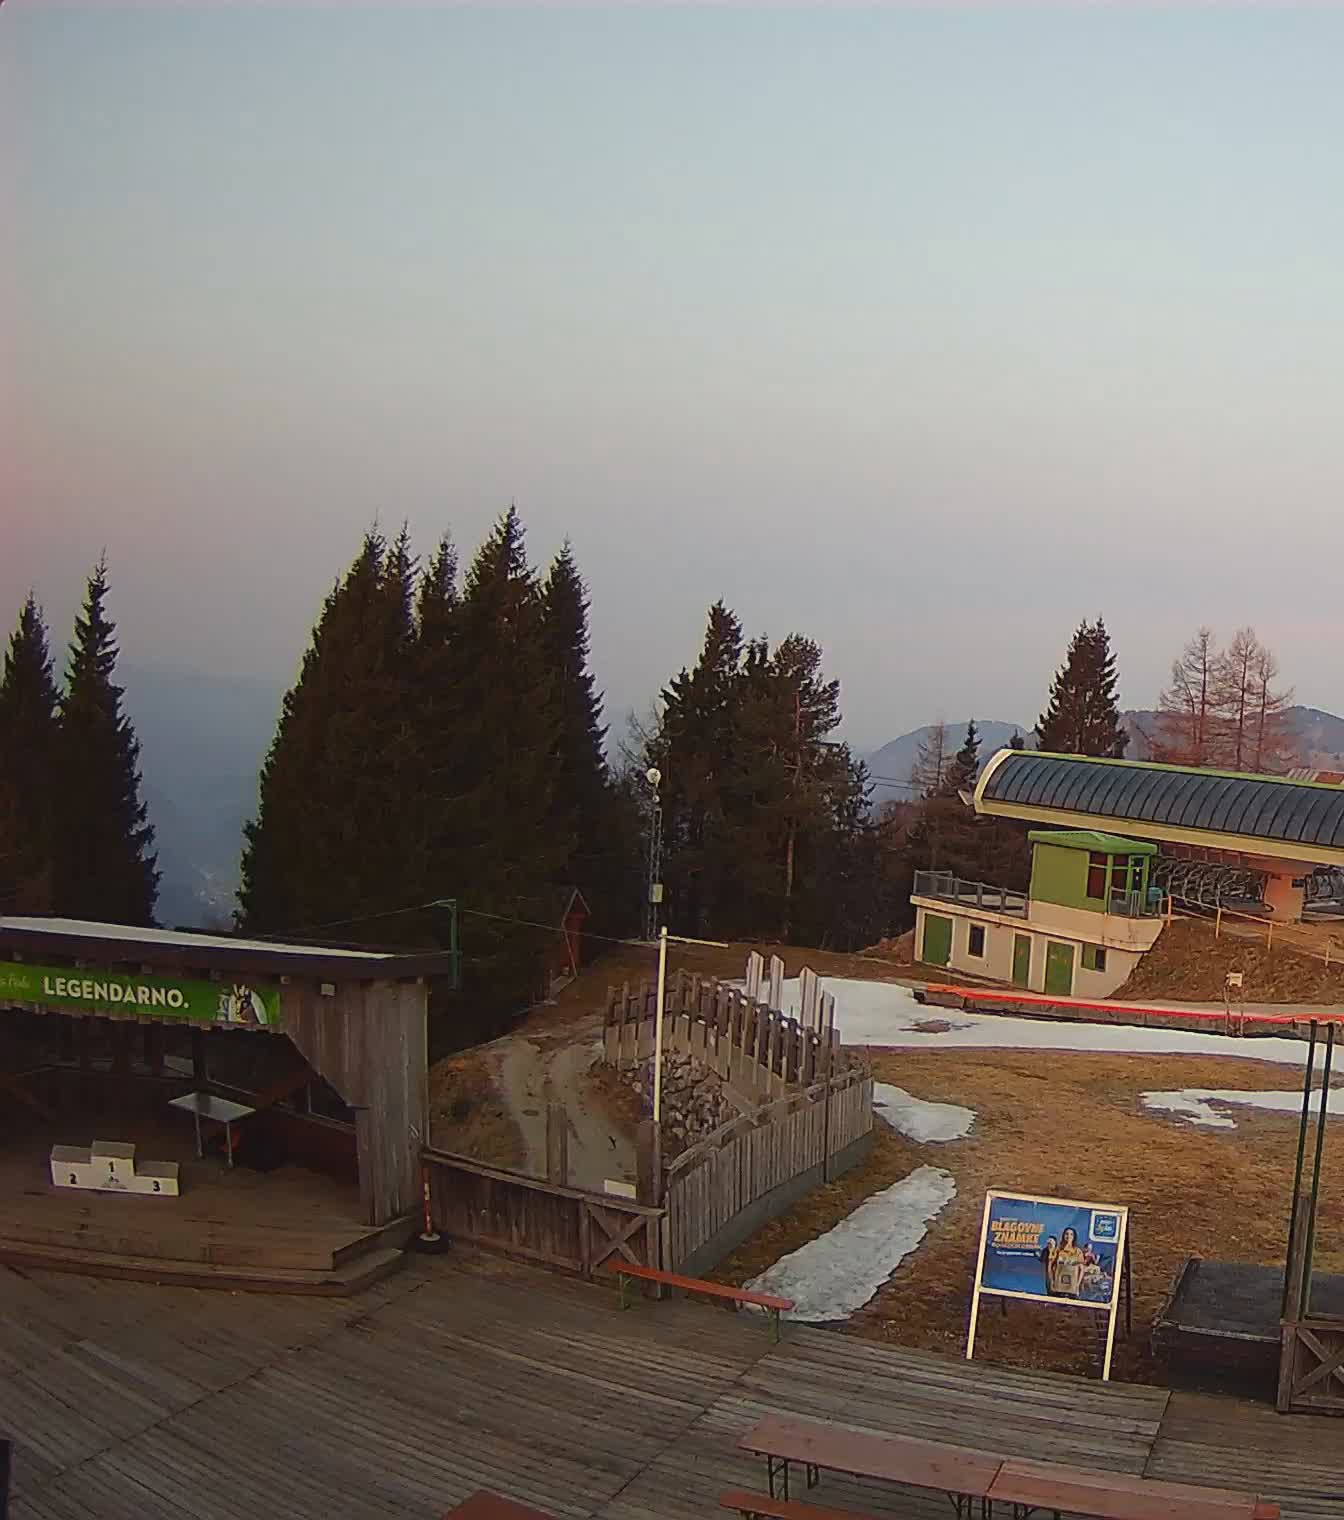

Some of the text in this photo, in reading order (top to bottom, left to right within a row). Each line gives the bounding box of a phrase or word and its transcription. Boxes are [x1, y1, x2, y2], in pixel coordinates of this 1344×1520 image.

[43, 976, 189, 1009] LEGENDARNO.
[108, 1161, 115, 1172] 1
[69, 1173, 77, 1184] 2
[153, 1181, 160, 1192] 3
